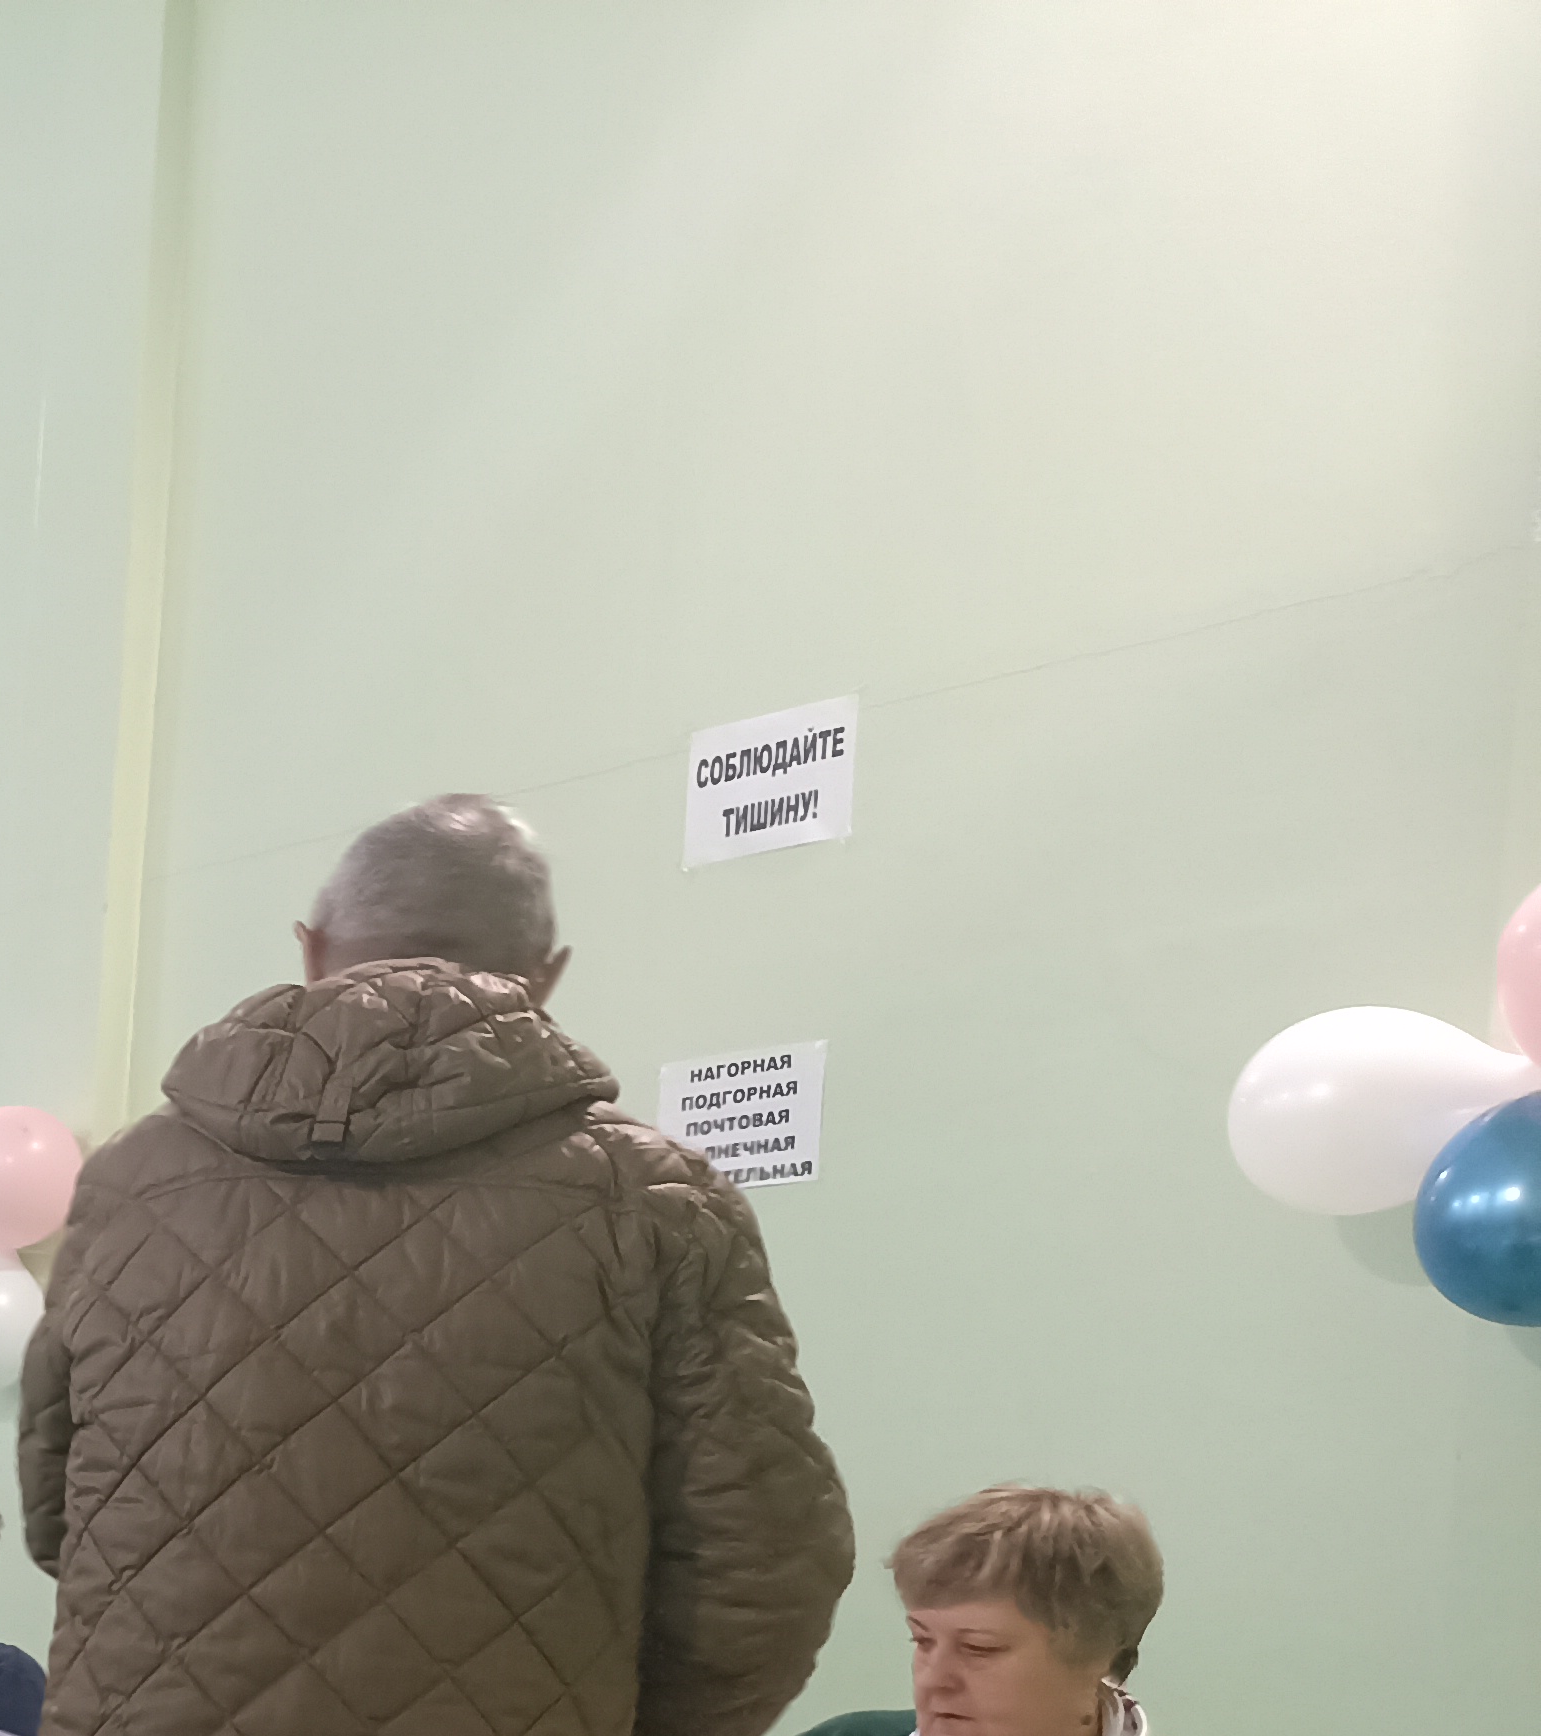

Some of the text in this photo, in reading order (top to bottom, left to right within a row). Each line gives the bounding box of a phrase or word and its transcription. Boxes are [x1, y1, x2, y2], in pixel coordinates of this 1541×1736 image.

[696, 726, 846, 789] СОБЛЮДАЙТЕ
[722, 789, 819, 838] ТИШИНУ!
[690, 1054, 792, 1083] НАГОРНАЯ
[681, 1080, 798, 1112] ПОДГОРНАЯ
[685, 1108, 790, 1137] ПОЧТОВАЯ
[705, 1135, 796, 1160] ЛНЕЧНАЯ
